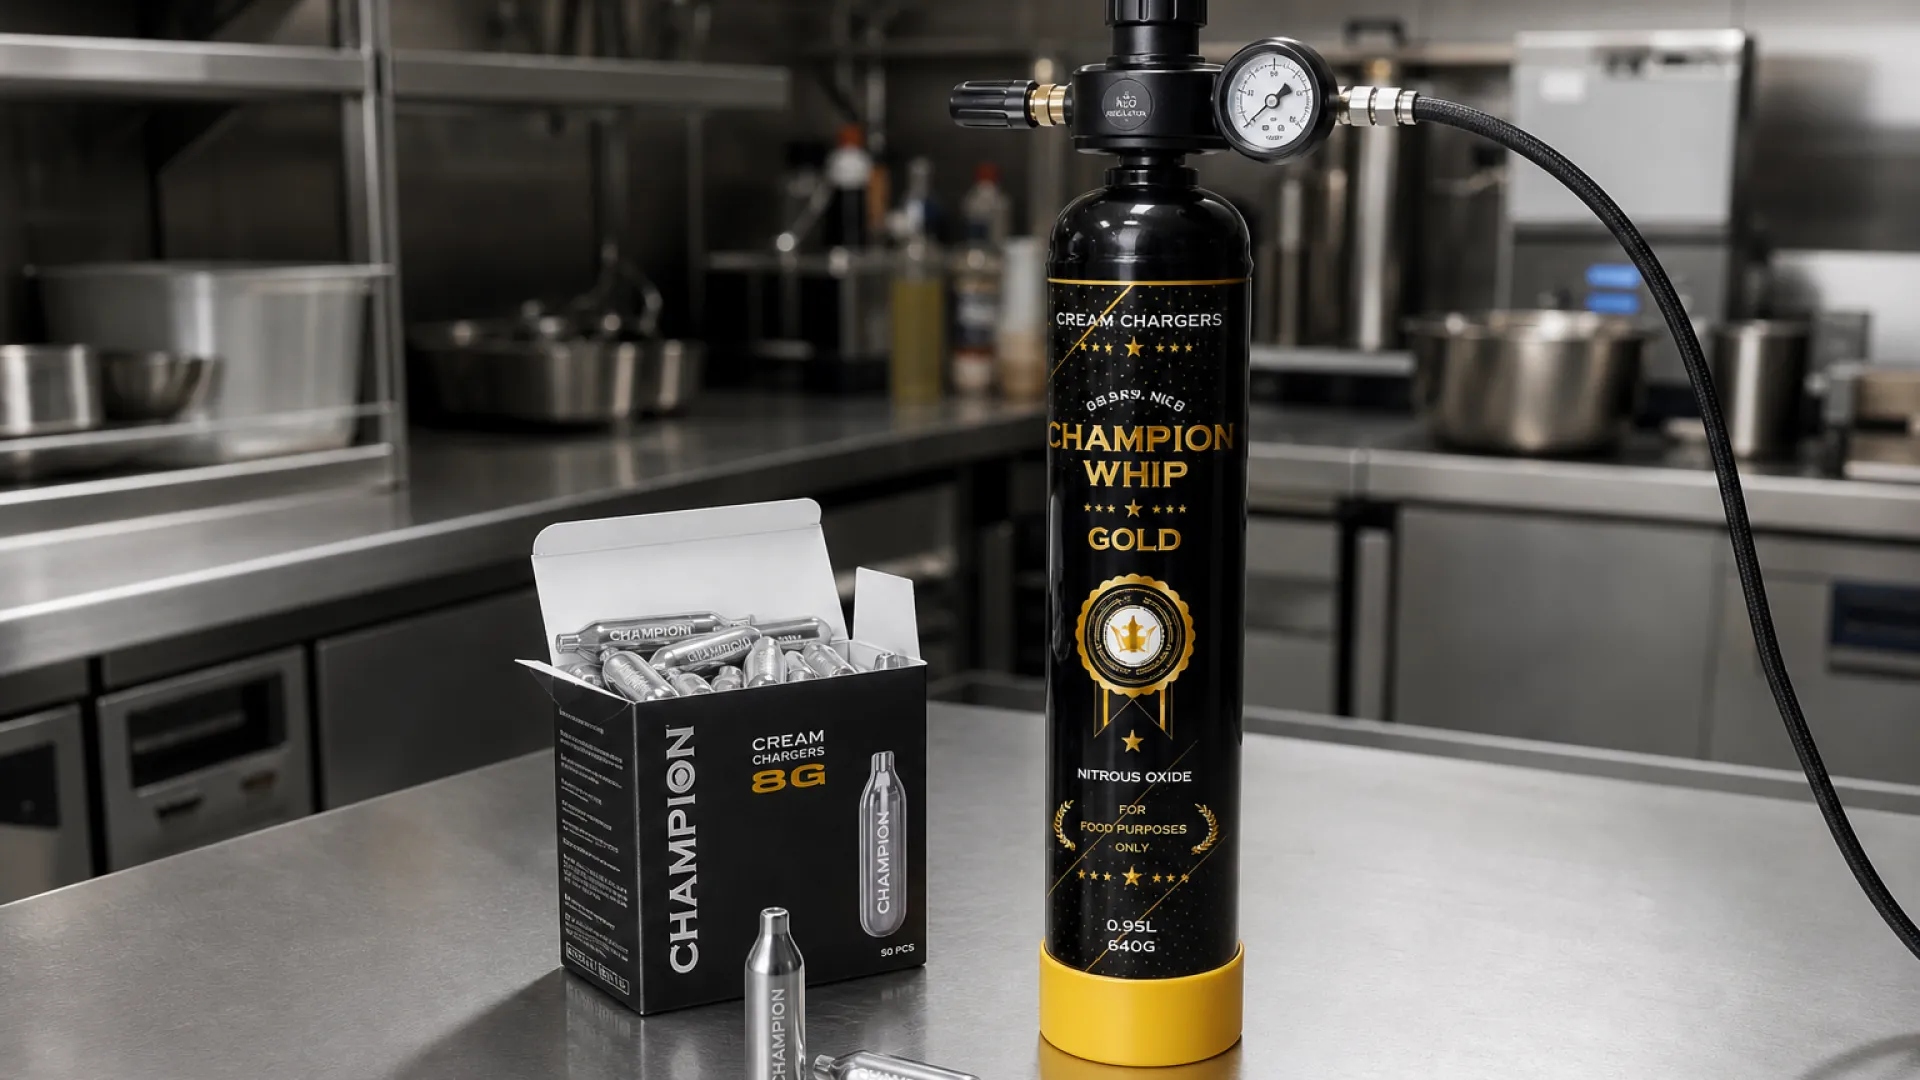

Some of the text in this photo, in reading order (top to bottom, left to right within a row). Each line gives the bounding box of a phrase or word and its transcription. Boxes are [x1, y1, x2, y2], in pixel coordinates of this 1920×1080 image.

[1056, 312, 1222, 328] CREAM CHARGERS
[1049, 421, 1234, 452] CHAMPION
[1083, 460, 1188, 488] WHIP
[1088, 526, 1181, 551] GOLD
[752, 729, 825, 751] CREAM
[752, 746, 825, 766] CHARGERS
[751, 763, 826, 793] 8G
[1077, 768, 1192, 783] NITROUS OXIDE
[1119, 804, 1146, 815] FOR
[1080, 821, 1187, 835] FOOD PURPOSES
[666, 726, 699, 973] CHAMPION
[1115, 843, 1149, 853] ONLY
[876, 811, 891, 914] CHAMPION
[895, 943, 915, 955] PCS
[1108, 939, 1156, 952] 640G
